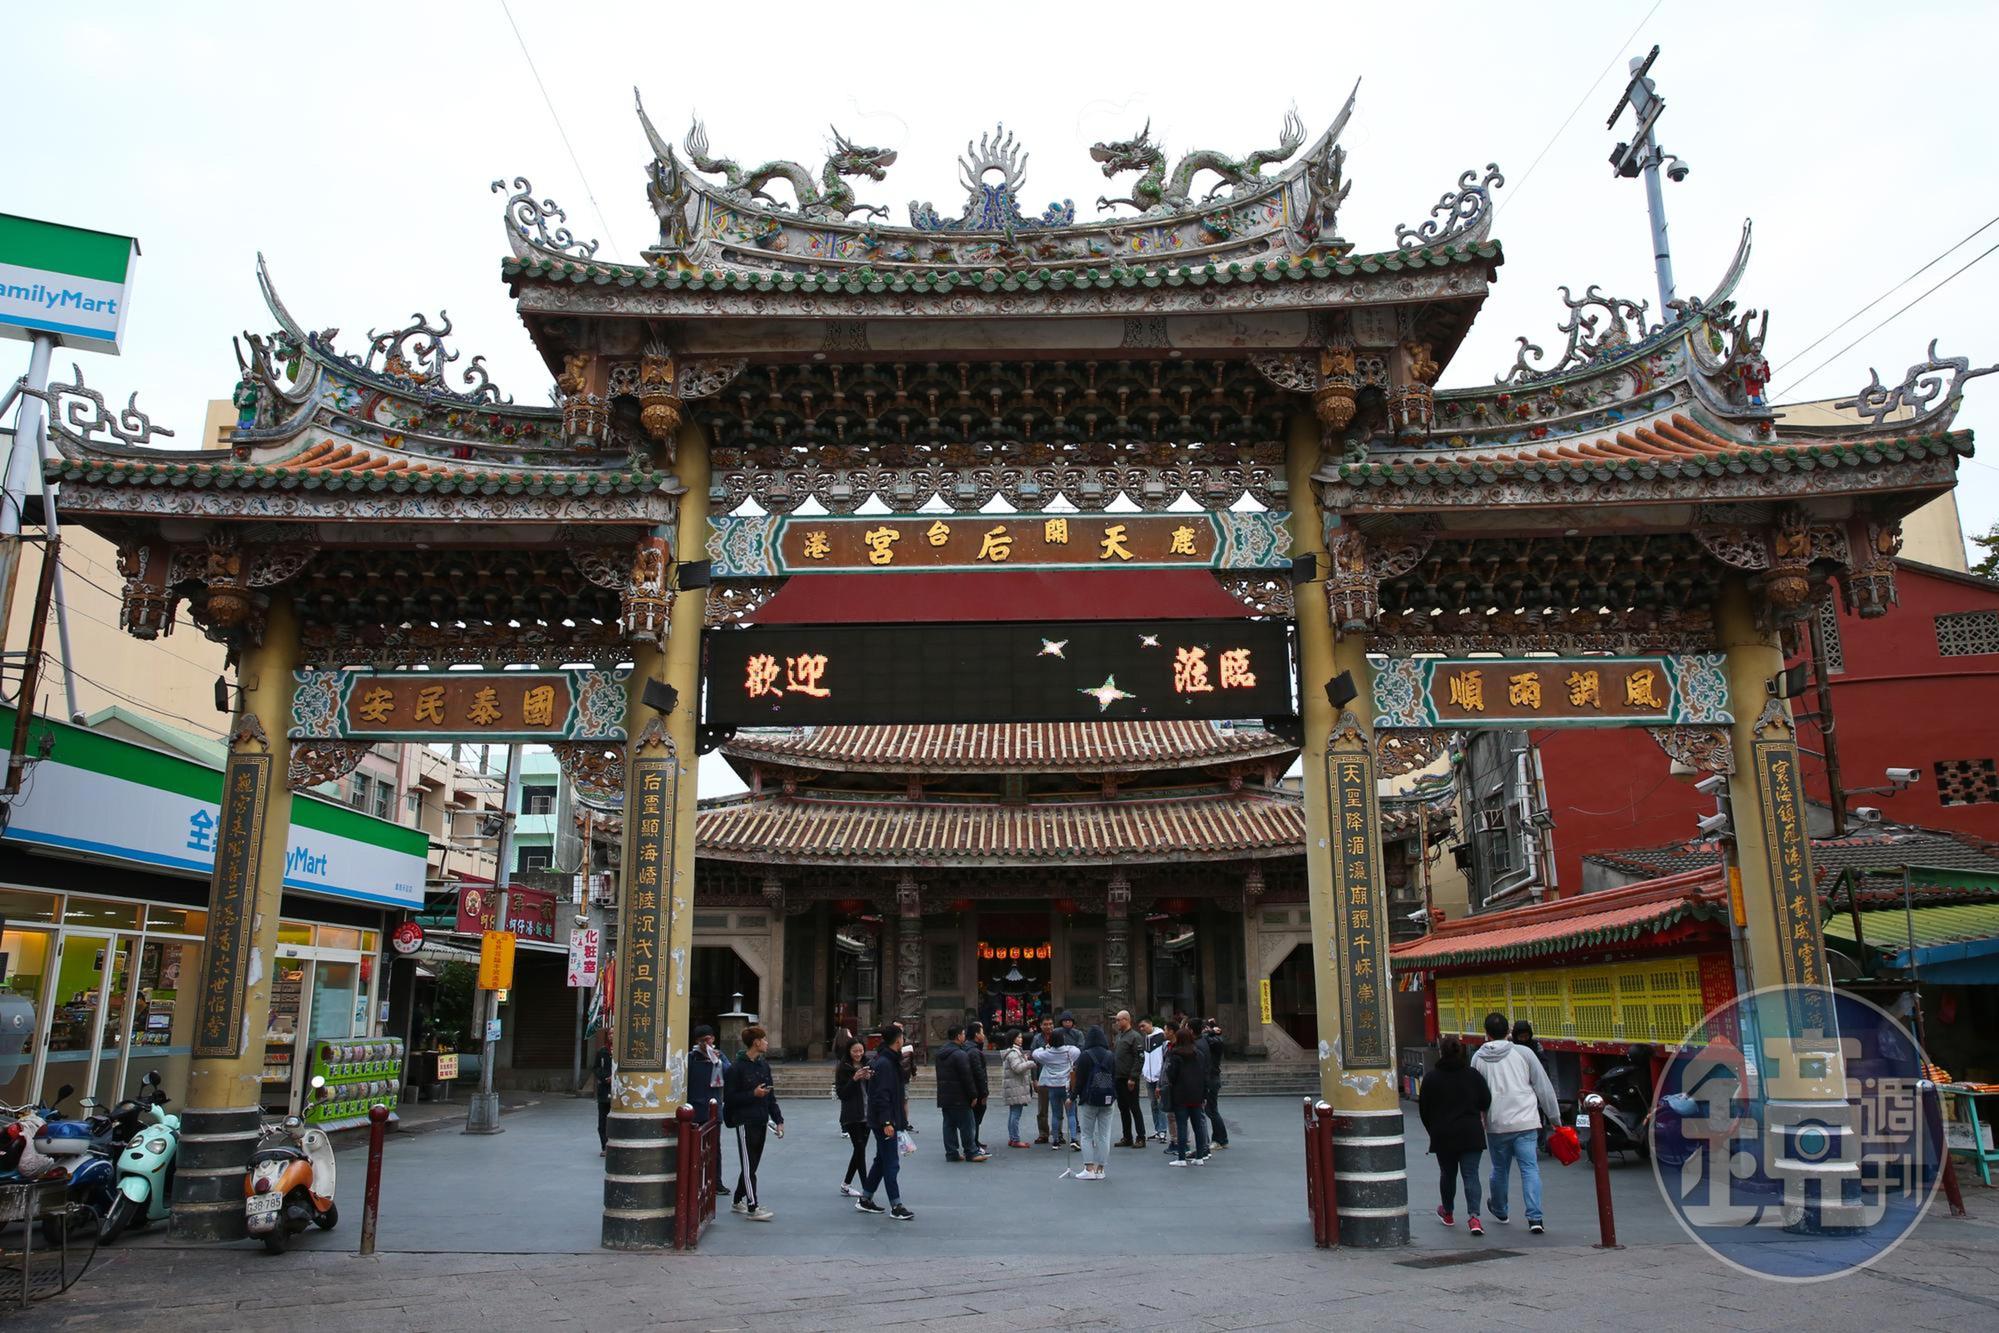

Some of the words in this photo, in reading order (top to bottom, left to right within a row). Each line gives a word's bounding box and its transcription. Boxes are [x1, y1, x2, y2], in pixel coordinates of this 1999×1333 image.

[0, 284, 117, 314] amilyMart
[745, 653, 831, 697] 歡迎
[1174, 646, 1257, 693] 蒞臨
[187, 809, 220, 853] 全
[285, 846, 327, 876] yMart
